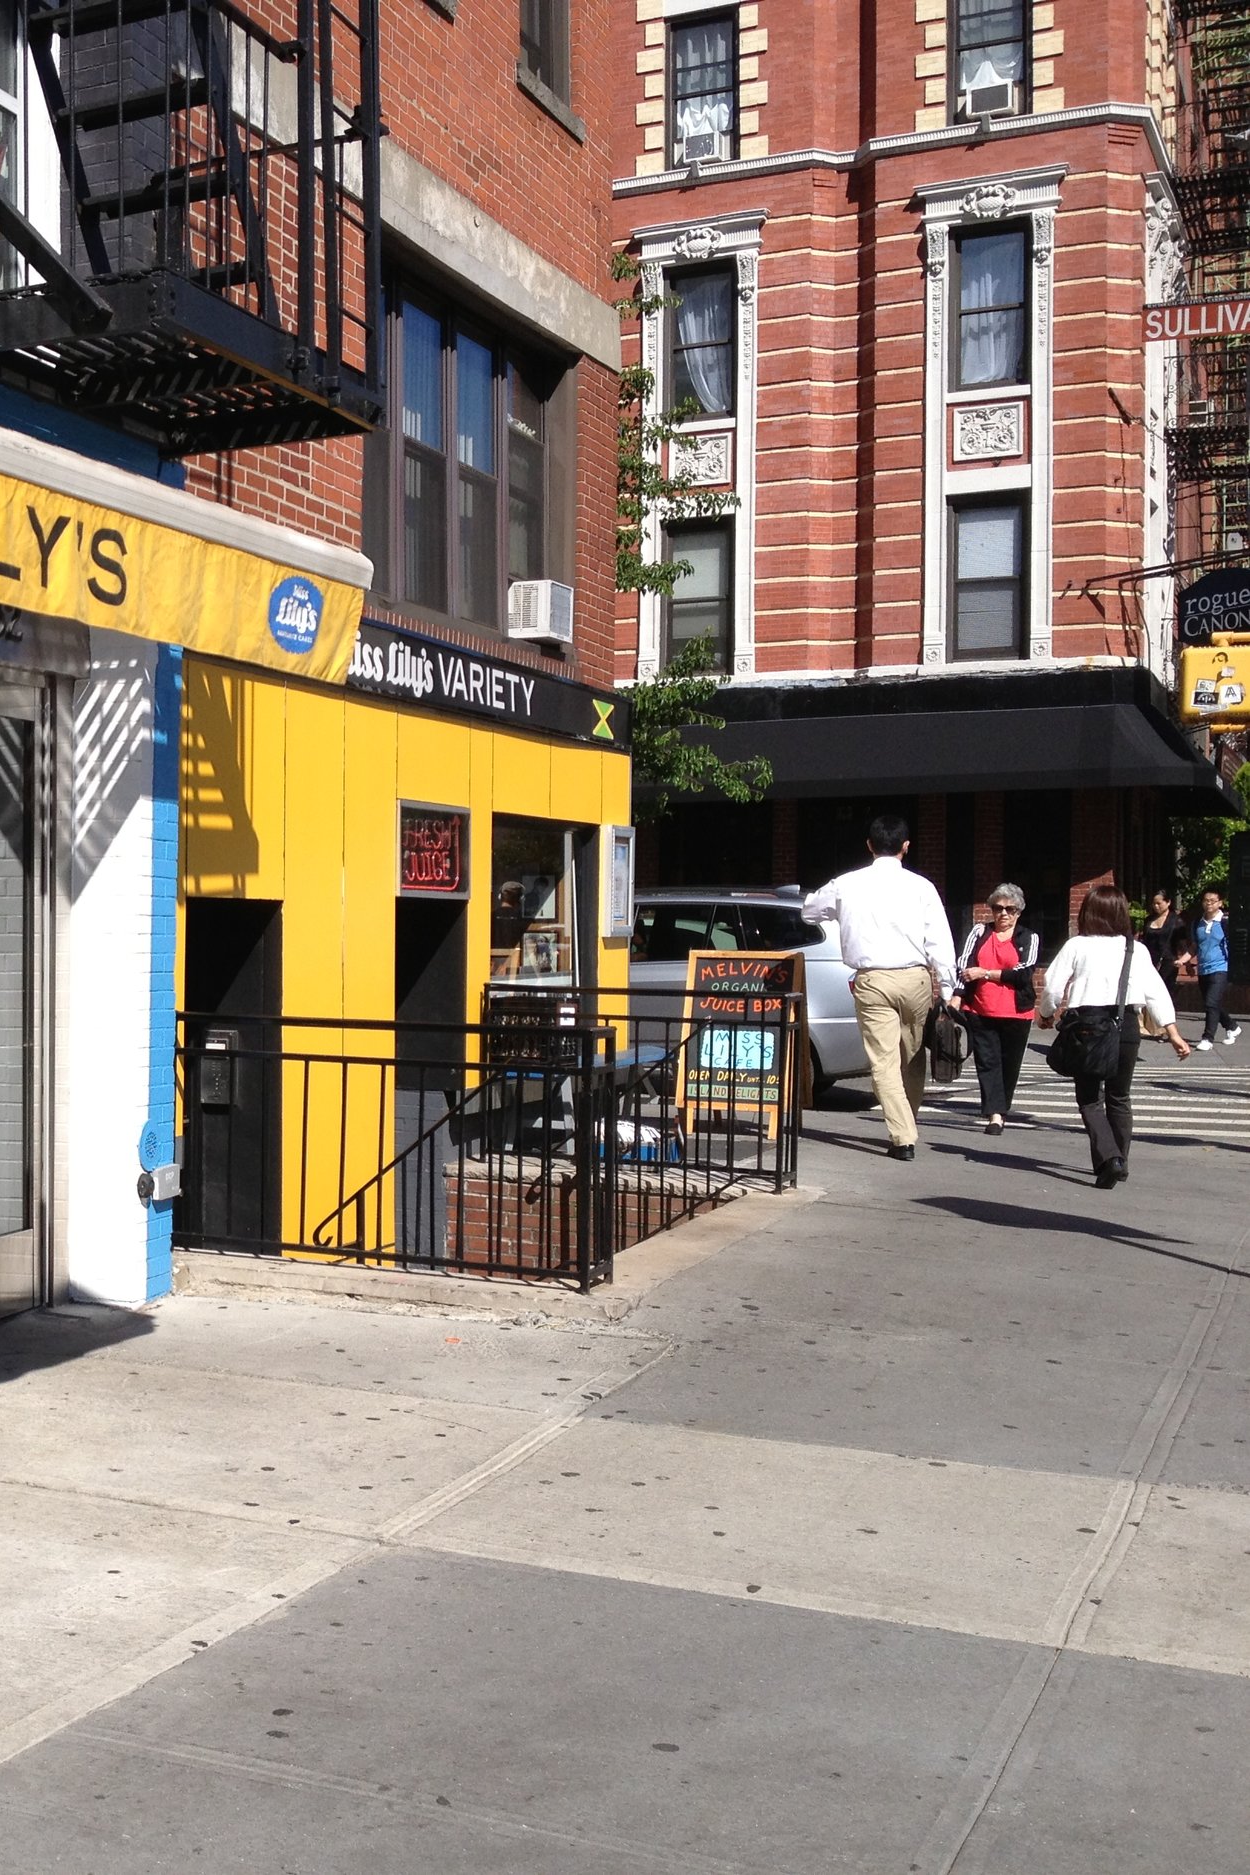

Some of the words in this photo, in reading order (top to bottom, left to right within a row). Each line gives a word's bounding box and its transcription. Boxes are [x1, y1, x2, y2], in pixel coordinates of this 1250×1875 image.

[1185, 588, 1250, 615] rogue
[275, 597, 317, 634] Lily's
[348, 630, 384, 682] iss
[386, 641, 434, 698] Lily's
[437, 652, 536, 717] VARIETY
[404, 851, 451, 880] JUICE
[702, 962, 788, 984] MELVIN'S
[700, 997, 745, 1013] JUICE
[753, 998, 782, 1013] BOX
[715, 1032, 763, 1045] MSS
